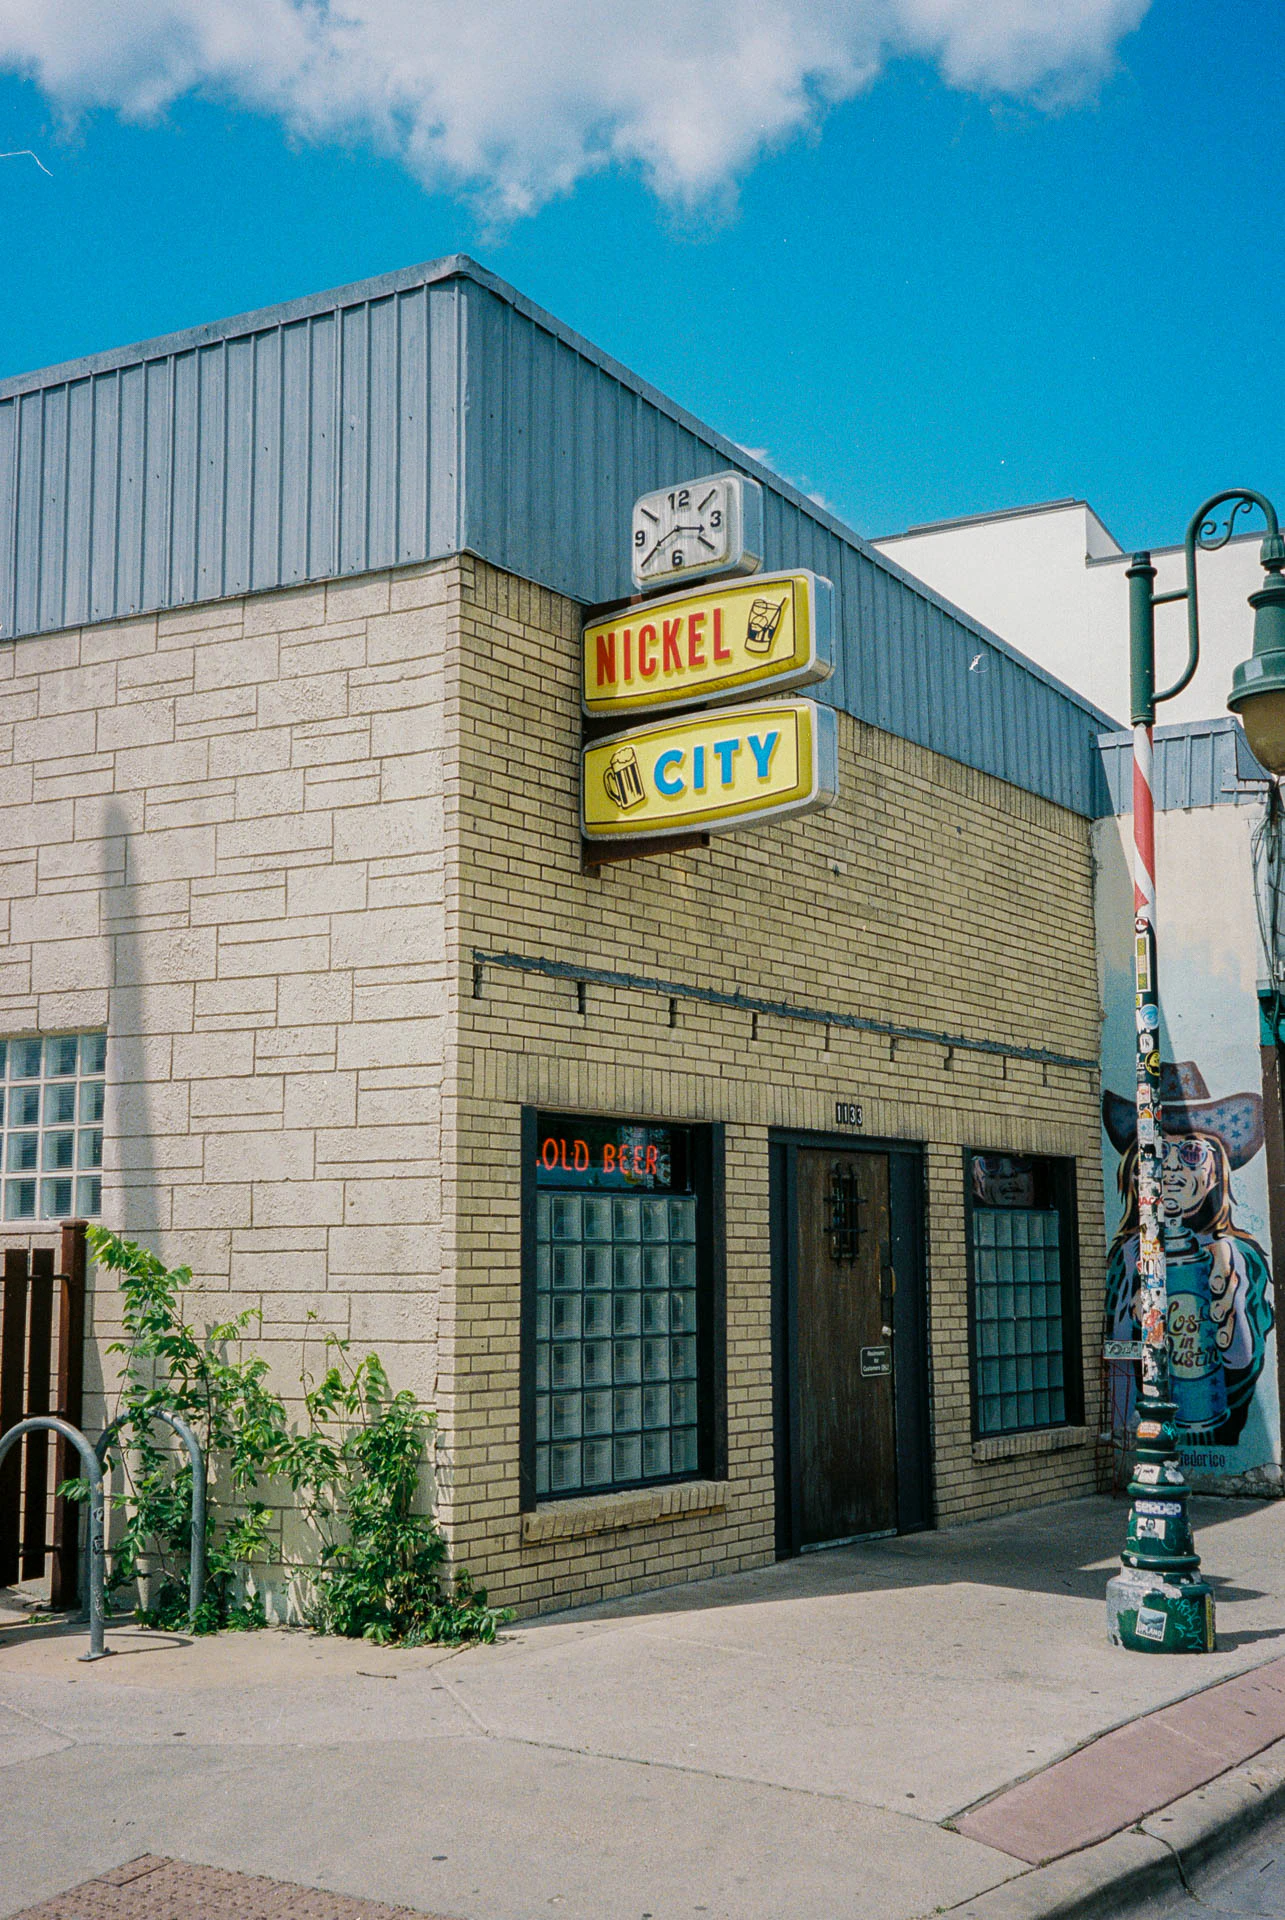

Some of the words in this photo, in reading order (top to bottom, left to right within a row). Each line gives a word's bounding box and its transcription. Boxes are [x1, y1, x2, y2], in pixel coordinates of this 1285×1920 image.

[667, 489, 690, 511] 12
[709, 510, 723, 528] 3
[634, 530, 646, 548] 9
[671, 548, 684, 567] 6
[596, 607, 731, 686] NICKEL
[653, 731, 779, 796] CITY
[837, 1104, 863, 1124] 1133
[536, 1137, 590, 1172] OLD
[602, 1143, 658, 1175] BEER
[1179, 1333, 1195, 1349] in
